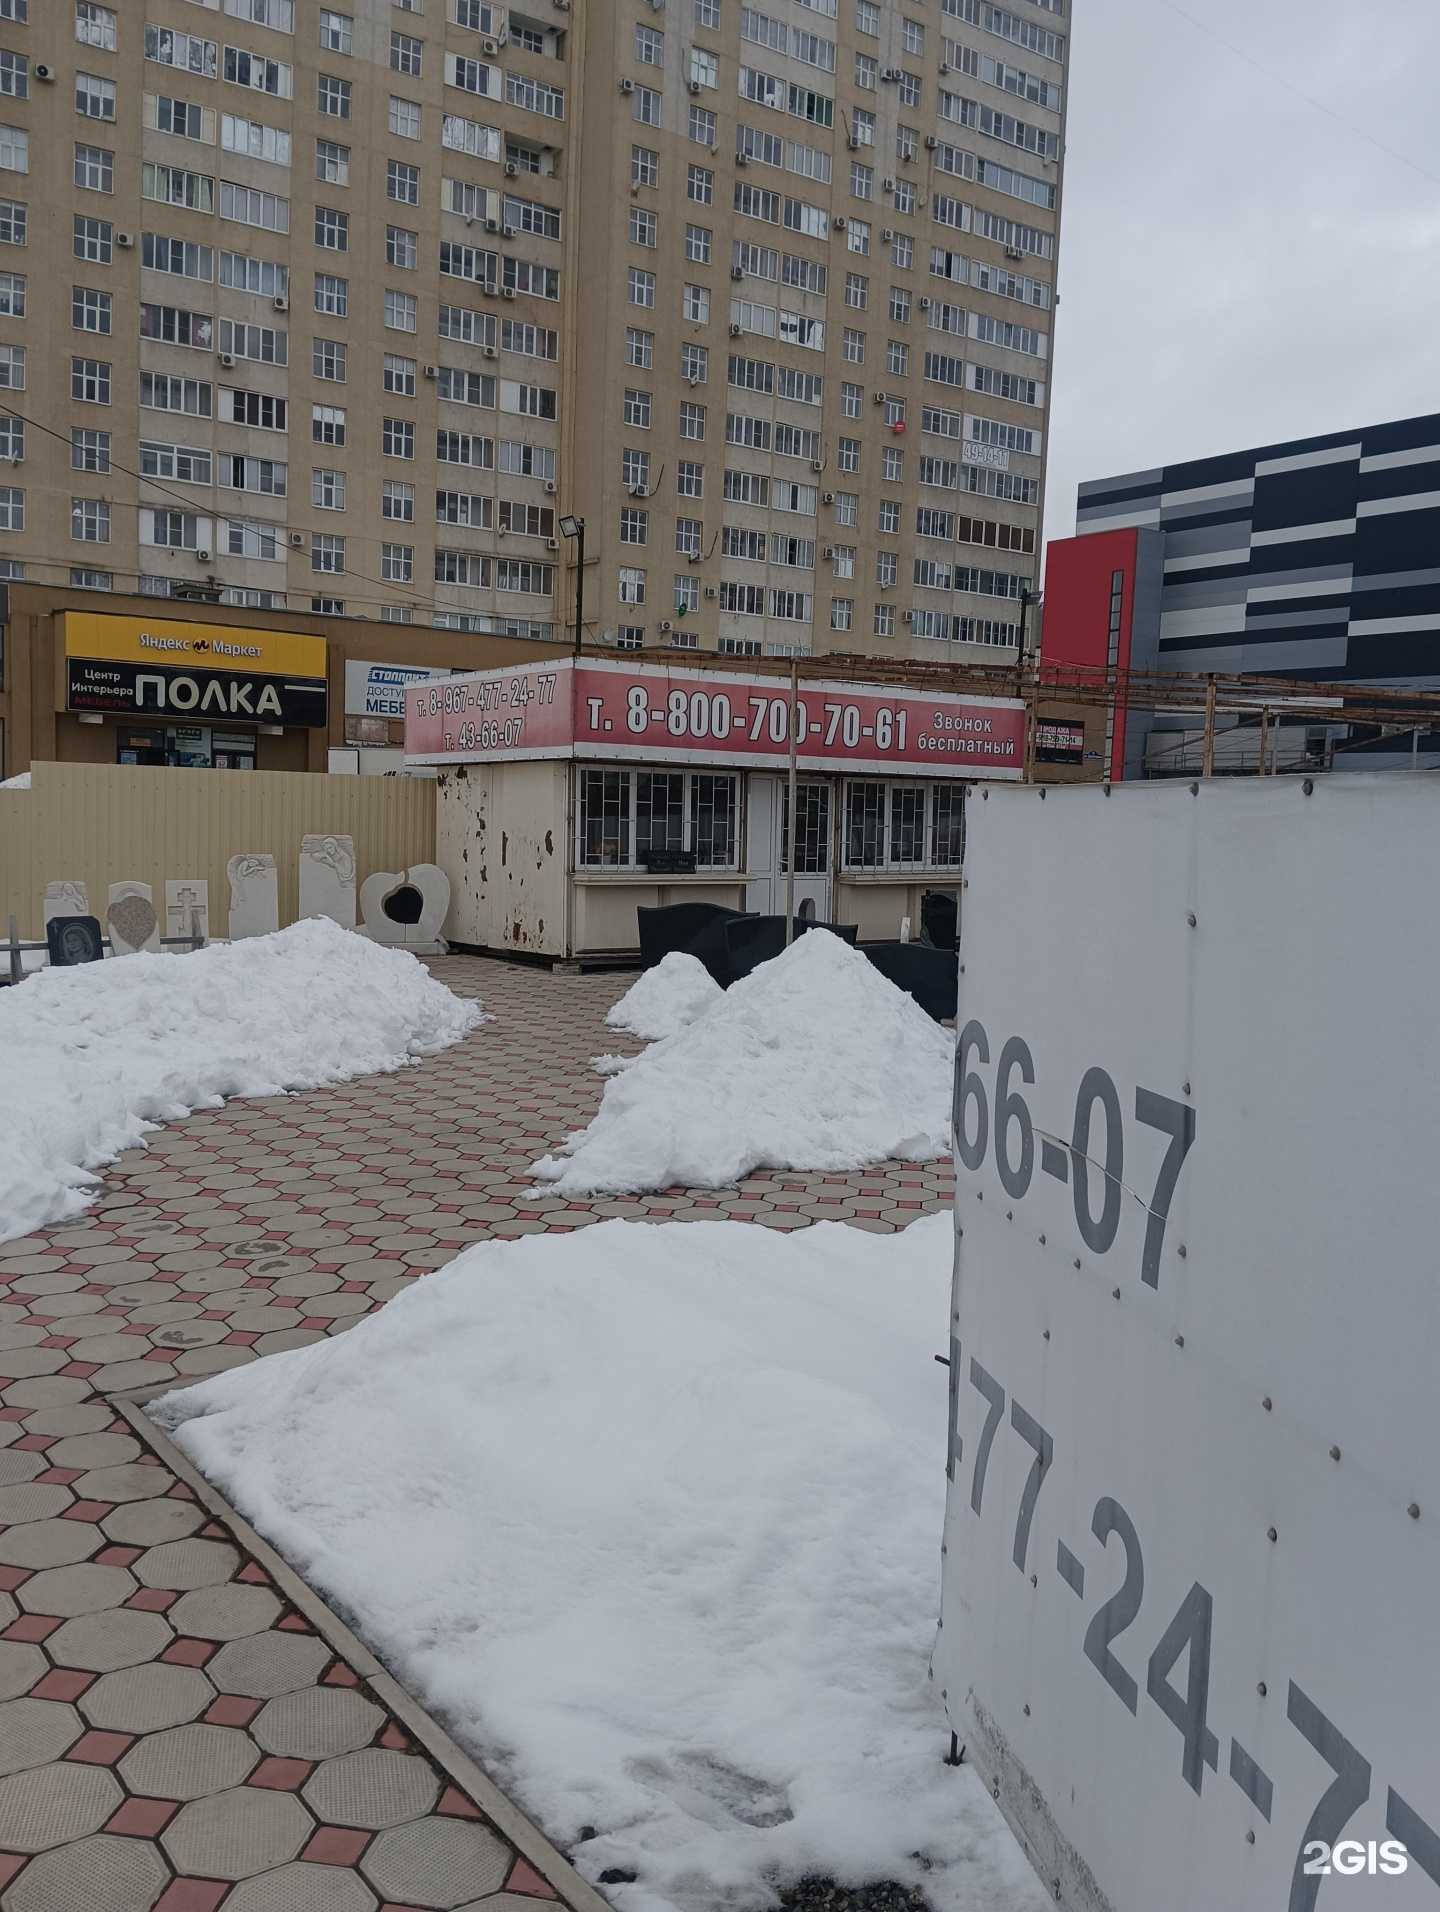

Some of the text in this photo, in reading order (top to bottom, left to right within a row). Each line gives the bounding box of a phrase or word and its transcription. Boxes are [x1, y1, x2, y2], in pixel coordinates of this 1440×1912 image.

[140, 633, 263, 657] Яндекс Маркет
[84, 668, 121, 683] Центр
[71, 682, 134, 696] Интерьера
[135, 674, 283, 716] ПОЛКА
[366, 686, 405, 698] ДОСТУ
[627, 685, 908, 750] 8-800-700-70-61
[933, 711, 993, 733] Звонок
[458, 717, 523, 750] 43-66-07
[917, 733, 1015, 756] бесплатный
[952, 1019, 1196, 1291] 66-07
